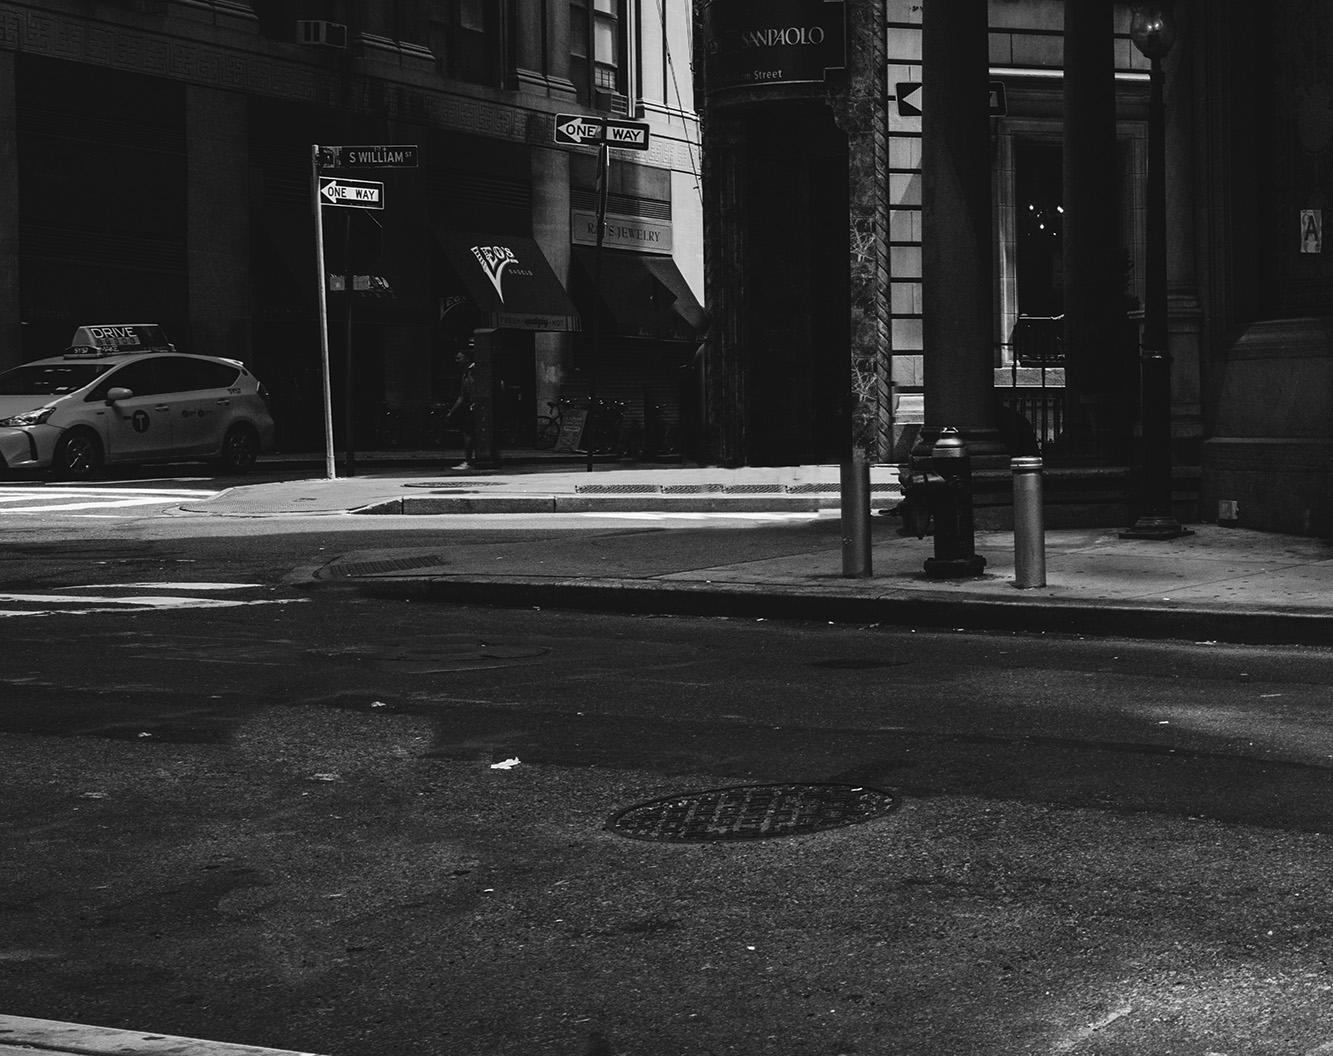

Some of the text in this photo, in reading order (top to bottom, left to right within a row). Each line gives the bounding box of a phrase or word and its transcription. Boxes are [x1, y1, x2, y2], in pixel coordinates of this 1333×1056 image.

[741, 26, 825, 49] SANPAOLO
[753, 69, 783, 81] Street
[566, 124, 641, 141] ONE WAY
[349, 151, 356, 164] S
[358, 150, 404, 164] WILLIAM
[327, 186, 375, 200] ONE WAY
[617, 226, 661, 242] JEWELRY
[90, 327, 137, 339] DRIVE
